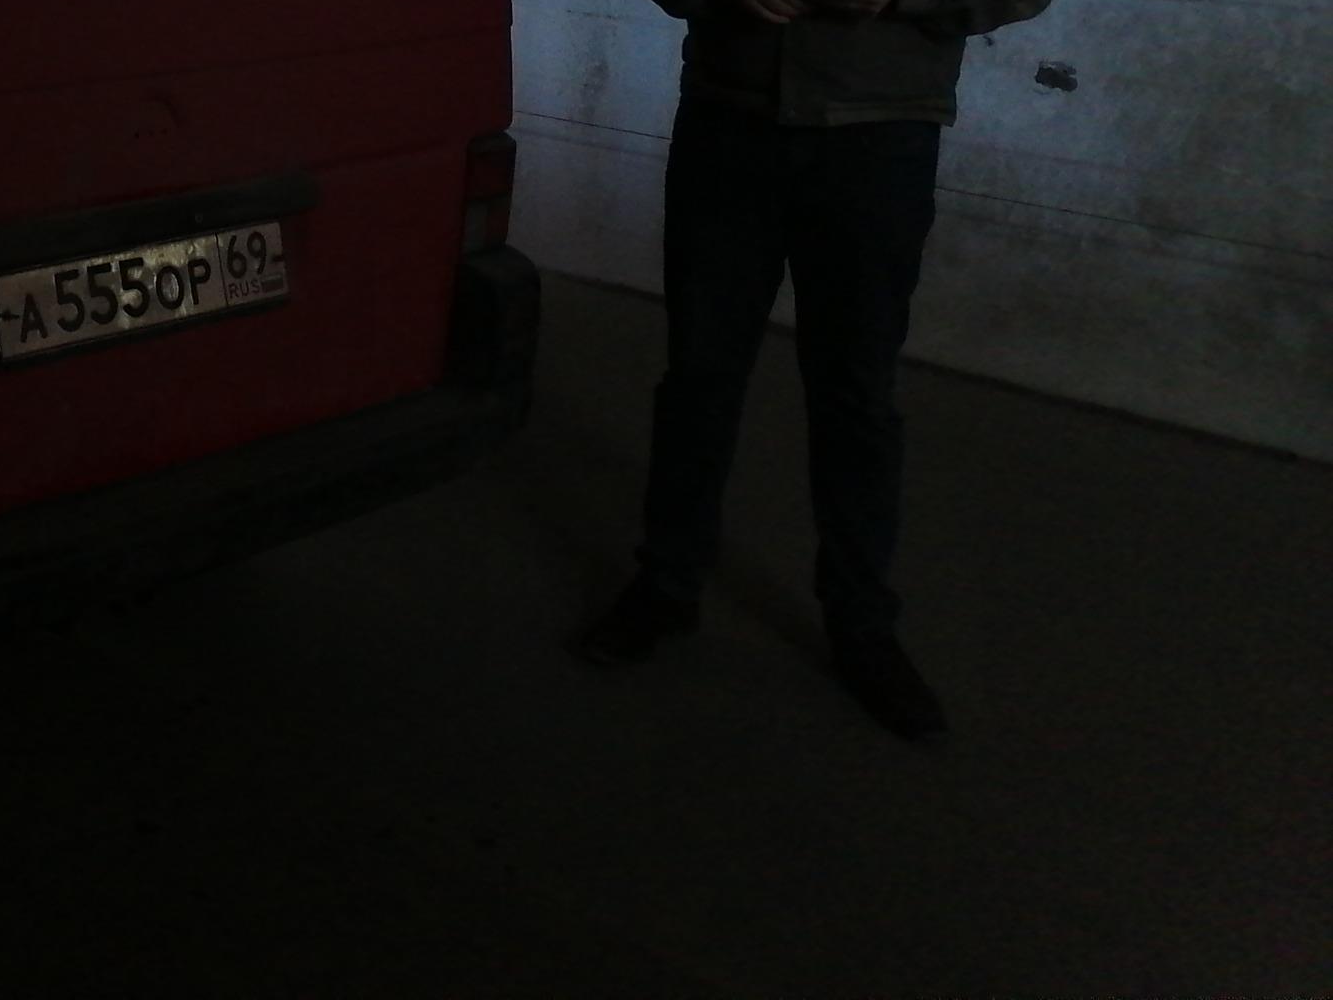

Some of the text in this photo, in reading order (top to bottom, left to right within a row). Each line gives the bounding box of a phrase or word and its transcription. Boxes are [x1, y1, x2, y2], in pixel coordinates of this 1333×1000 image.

[20, 231, 267, 343] А555ОР 69
[228, 282, 261, 300] RUS
